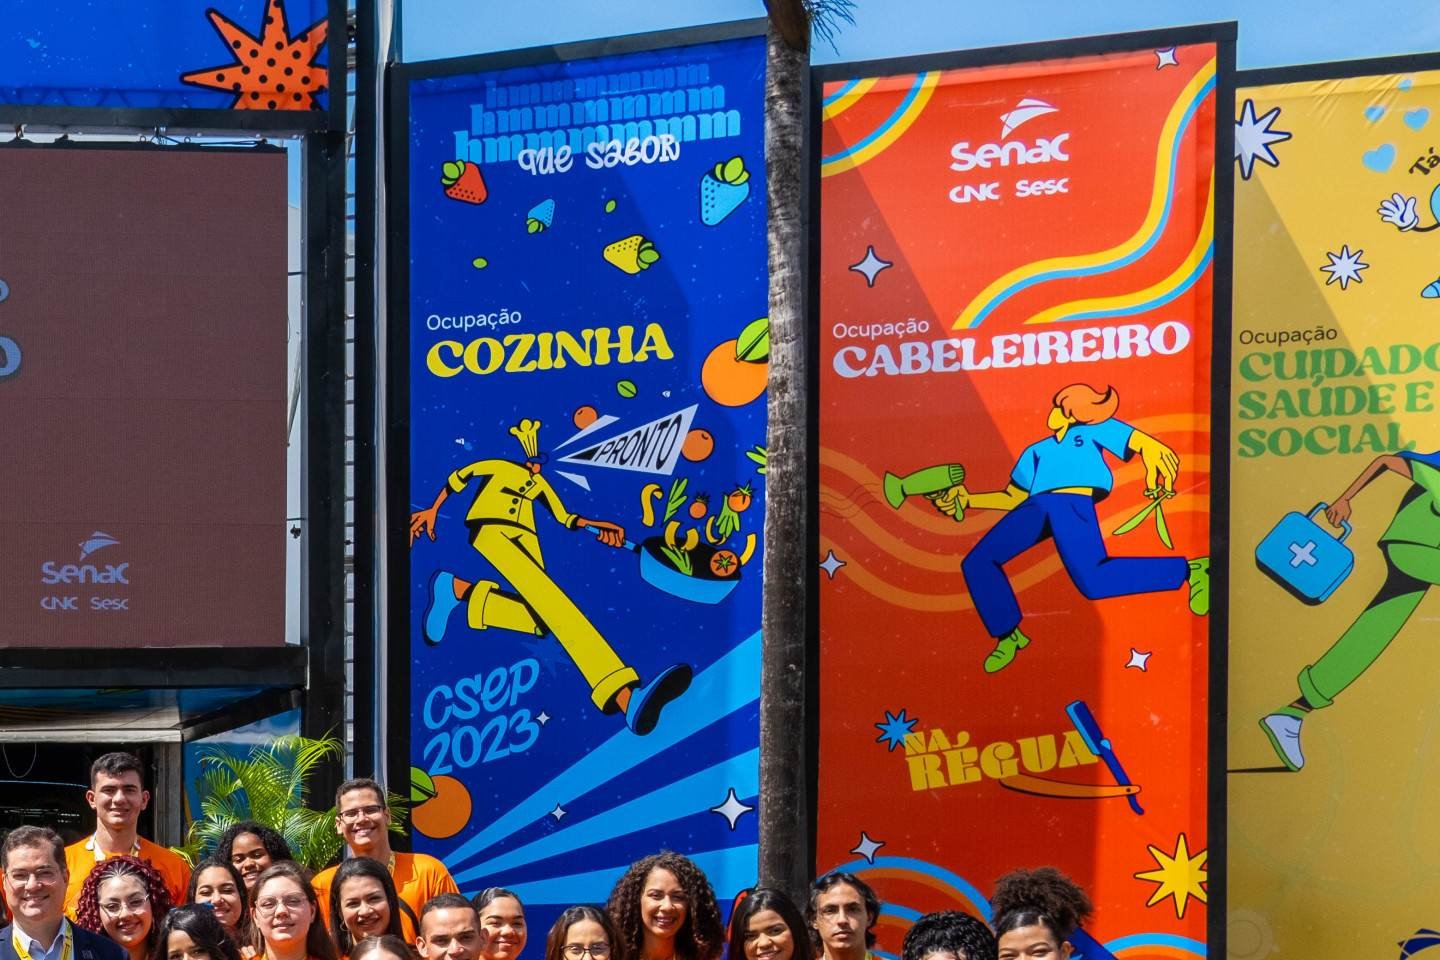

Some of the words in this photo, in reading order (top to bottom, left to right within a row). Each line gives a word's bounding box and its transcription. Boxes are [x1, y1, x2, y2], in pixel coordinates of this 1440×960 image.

[949, 133, 1070, 172] Senac
[948, 181, 1001, 204] CNC
[1015, 177, 1070, 198] Sesc
[426, 309, 522, 333] Ocupação
[832, 317, 930, 341] Ocupação
[1238, 325, 1338, 347] Ocupação
[426, 322, 675, 378] COZINHA
[832, 320, 1191, 379] CABELEIREIRO
[1237, 374, 1397, 420] SAÚDE
[1403, 380, 1435, 413] E
[594, 413, 683, 470] PRONTO
[1237, 422, 1417, 459] SOCIAL
[40, 561, 130, 585] Senac
[40, 597, 79, 610] CNC
[90, 597, 129, 610] Sesc
[423, 708, 540, 777] 2023
